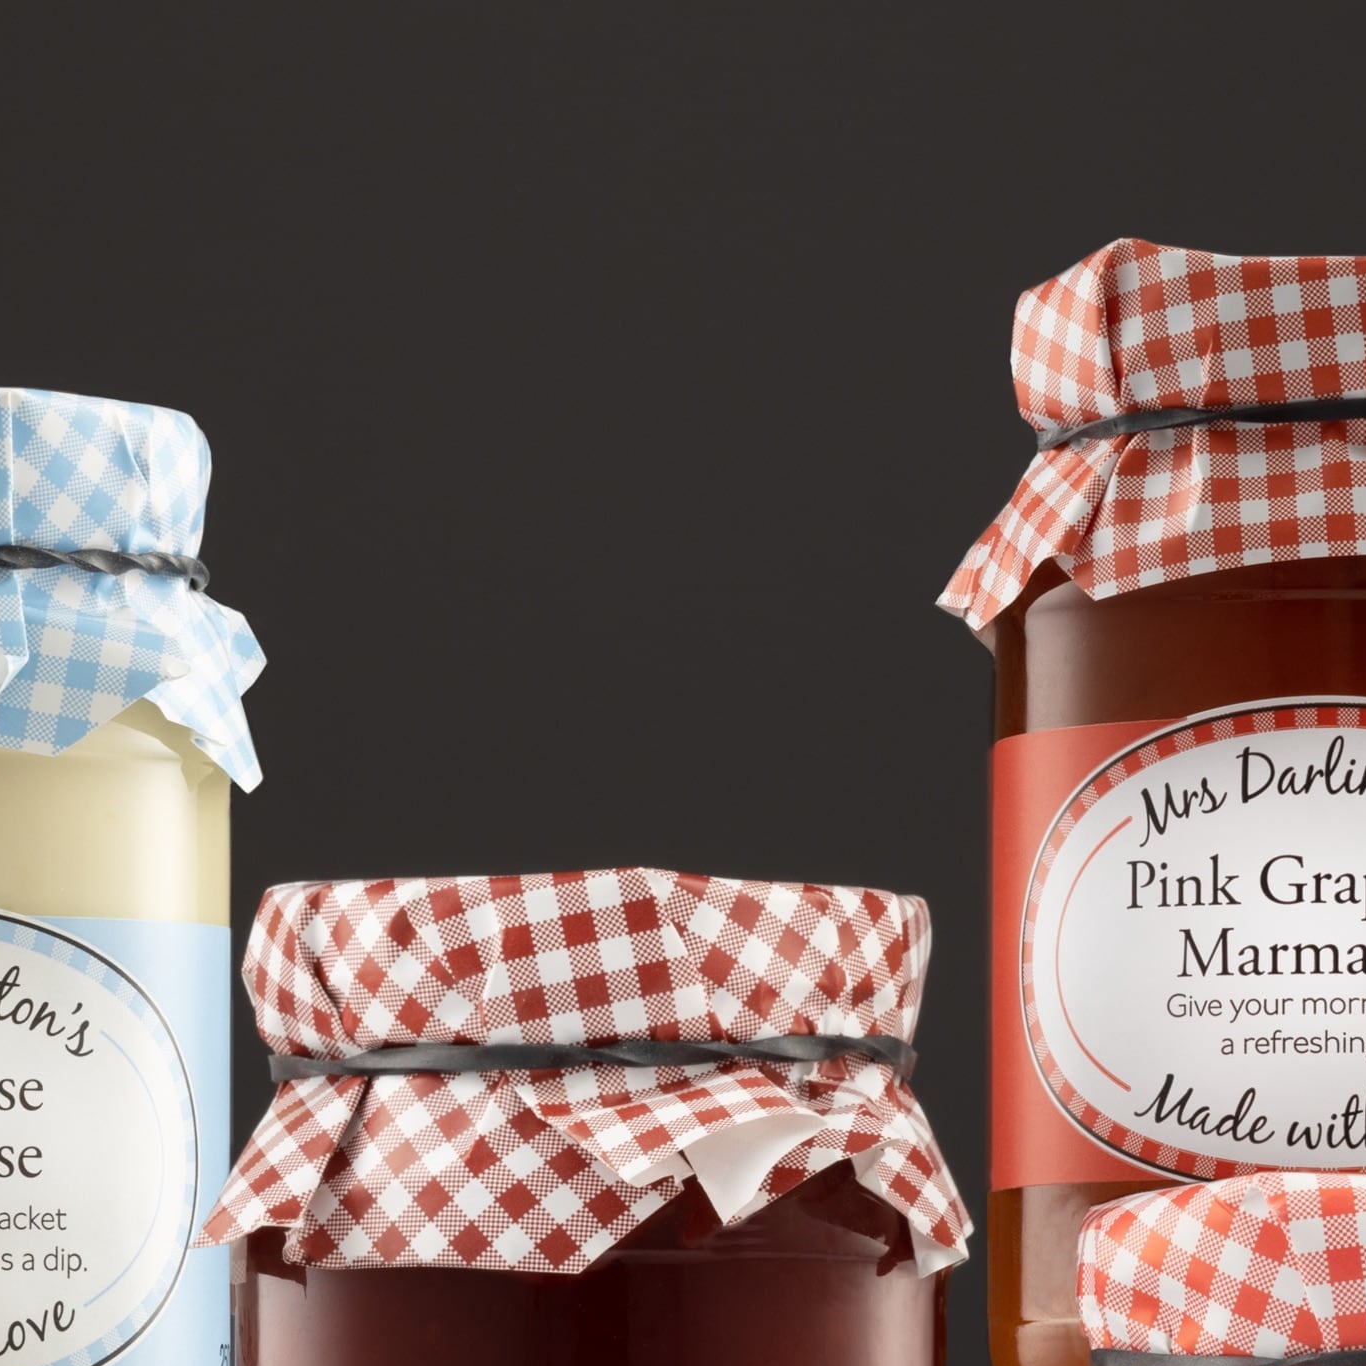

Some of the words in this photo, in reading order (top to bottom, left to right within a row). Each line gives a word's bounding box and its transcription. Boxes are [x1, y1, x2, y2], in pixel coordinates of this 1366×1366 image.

[1139, 776, 1228, 848] Mrs
[1126, 853, 1242, 910] Pink
[1166, 992, 1223, 1018] Give
[1229, 997, 1294, 1024] your
[1220, 1037, 1234, 1056] a
[1133, 1073, 1276, 1145] Made
[21, 1252, 35, 1272] a
[43, 1245, 88, 1280] dip.
